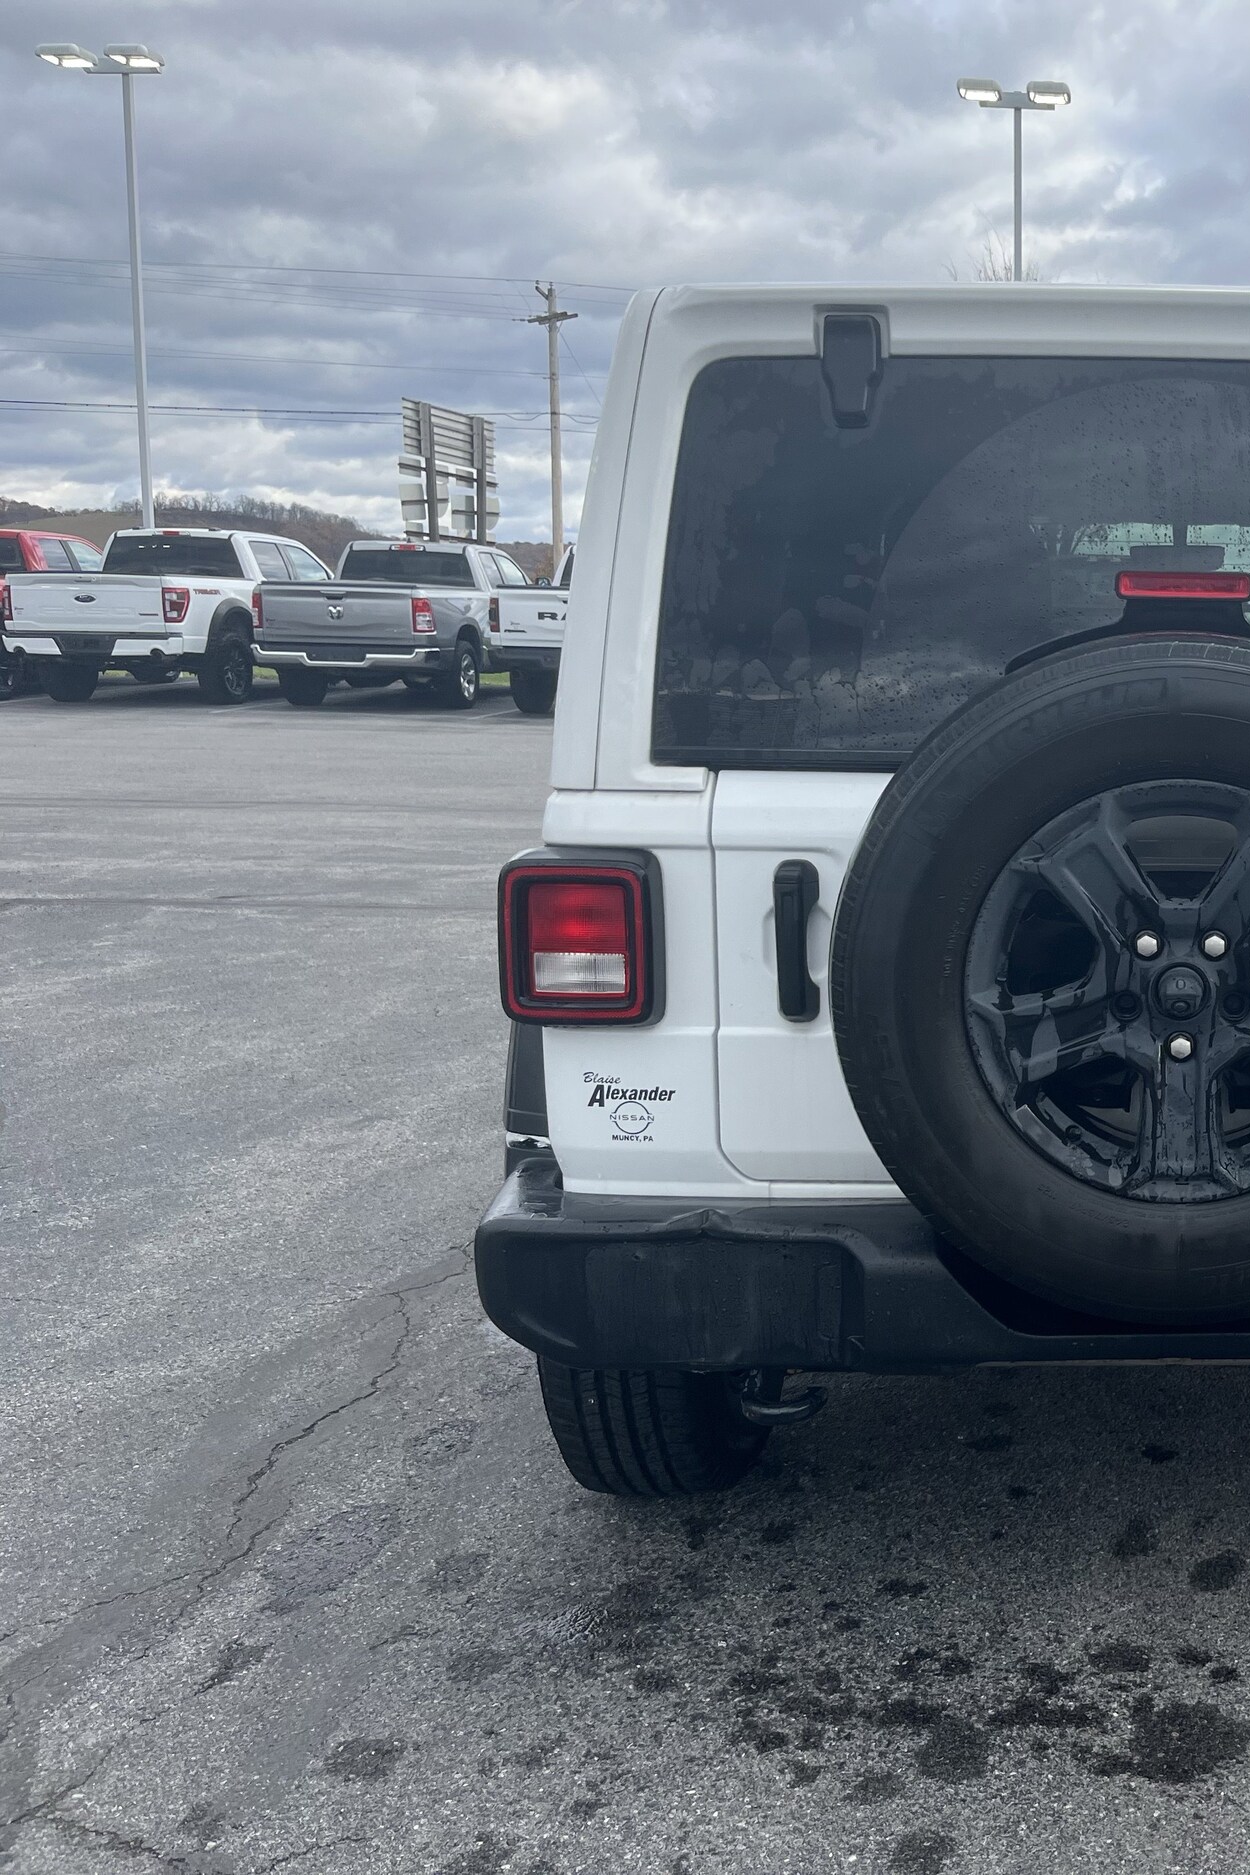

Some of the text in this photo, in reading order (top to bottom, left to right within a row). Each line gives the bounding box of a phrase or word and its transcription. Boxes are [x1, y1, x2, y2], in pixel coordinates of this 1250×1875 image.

[583, 1072, 621, 1084] Blaise
[587, 1084, 676, 1107] Alexander
[609, 1113, 654, 1122] NISSAN
[611, 1134, 642, 1142] MUNCY,
